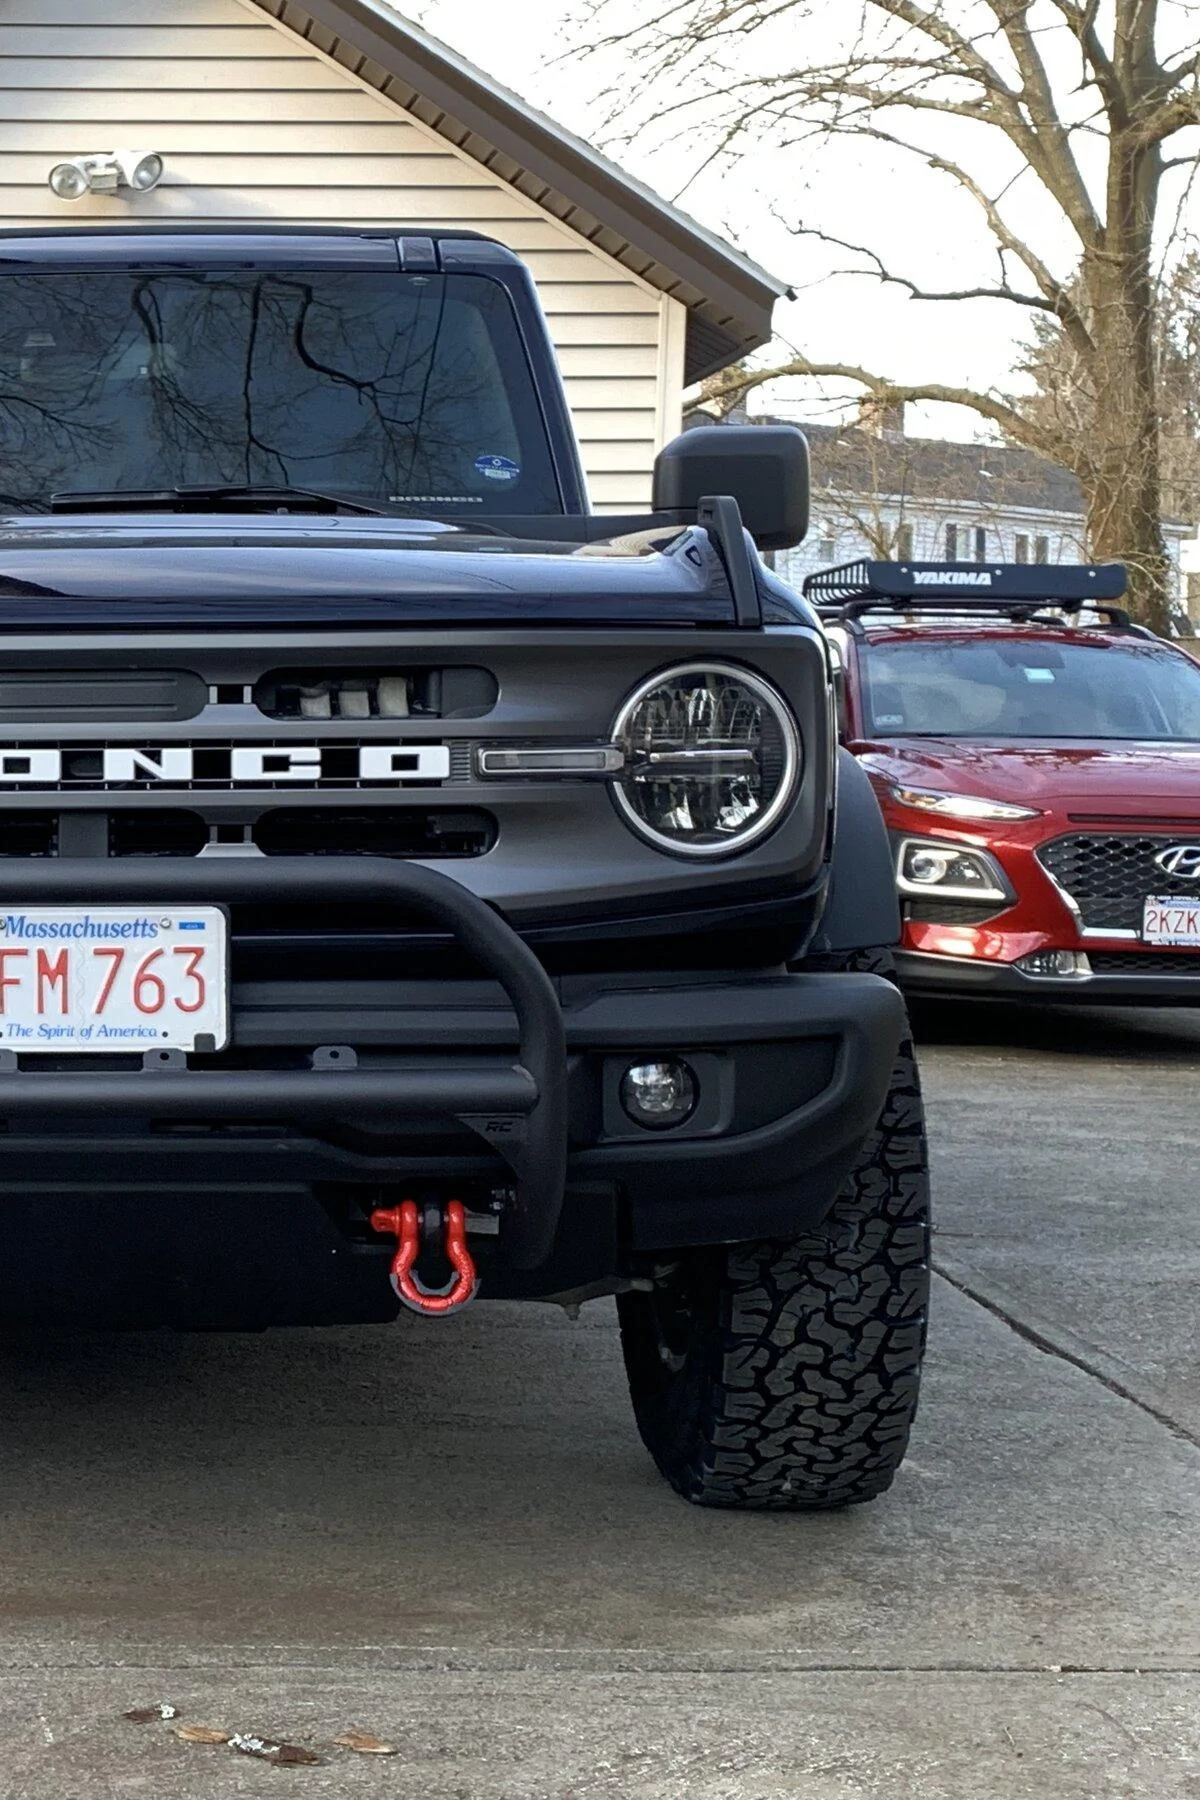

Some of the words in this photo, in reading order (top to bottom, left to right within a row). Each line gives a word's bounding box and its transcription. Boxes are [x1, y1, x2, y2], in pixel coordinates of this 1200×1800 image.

[913, 571, 991, 585] YAKIMA
[5, 915, 158, 938] Massachusetts
[93, 947, 205, 1013] 763
[7, 1023, 33, 1037] The
[37, 1023, 75, 1040] Spirit
[80, 1024, 94, 1040] of
[96, 1023, 158, 1038] America
